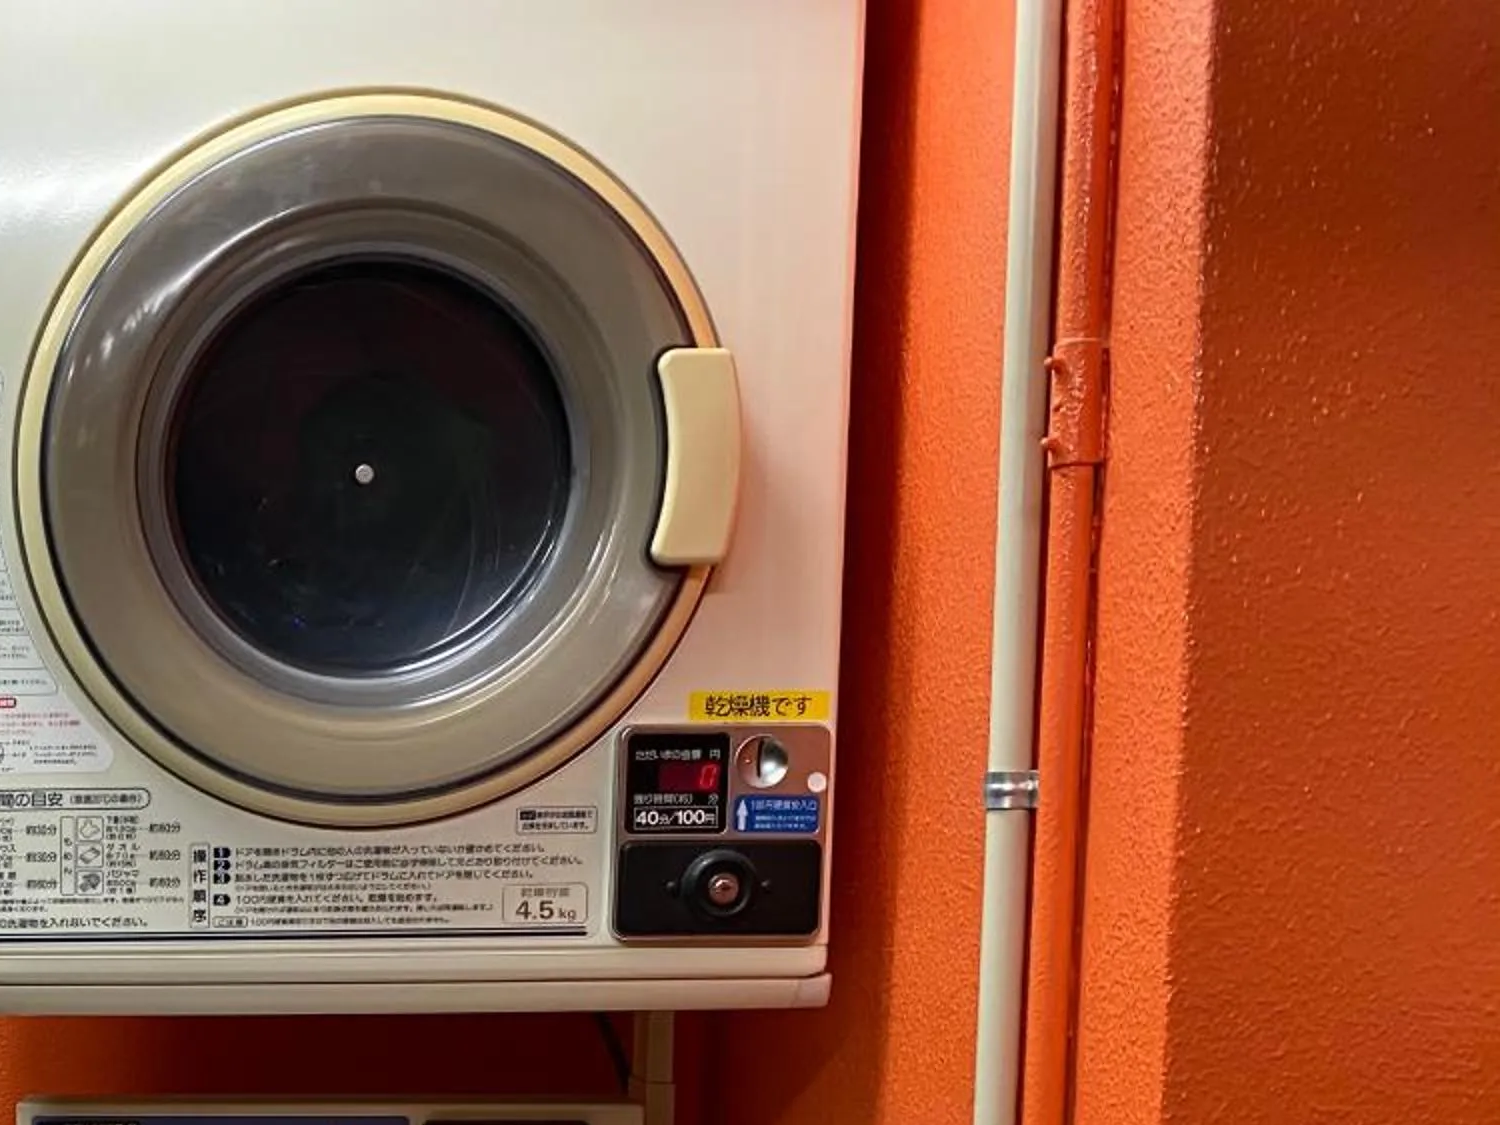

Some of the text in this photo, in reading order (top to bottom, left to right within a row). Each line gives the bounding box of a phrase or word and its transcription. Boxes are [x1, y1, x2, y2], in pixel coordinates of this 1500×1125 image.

[705, 696, 811, 716] 乾燥機です
[700, 763, 717, 789] 0
